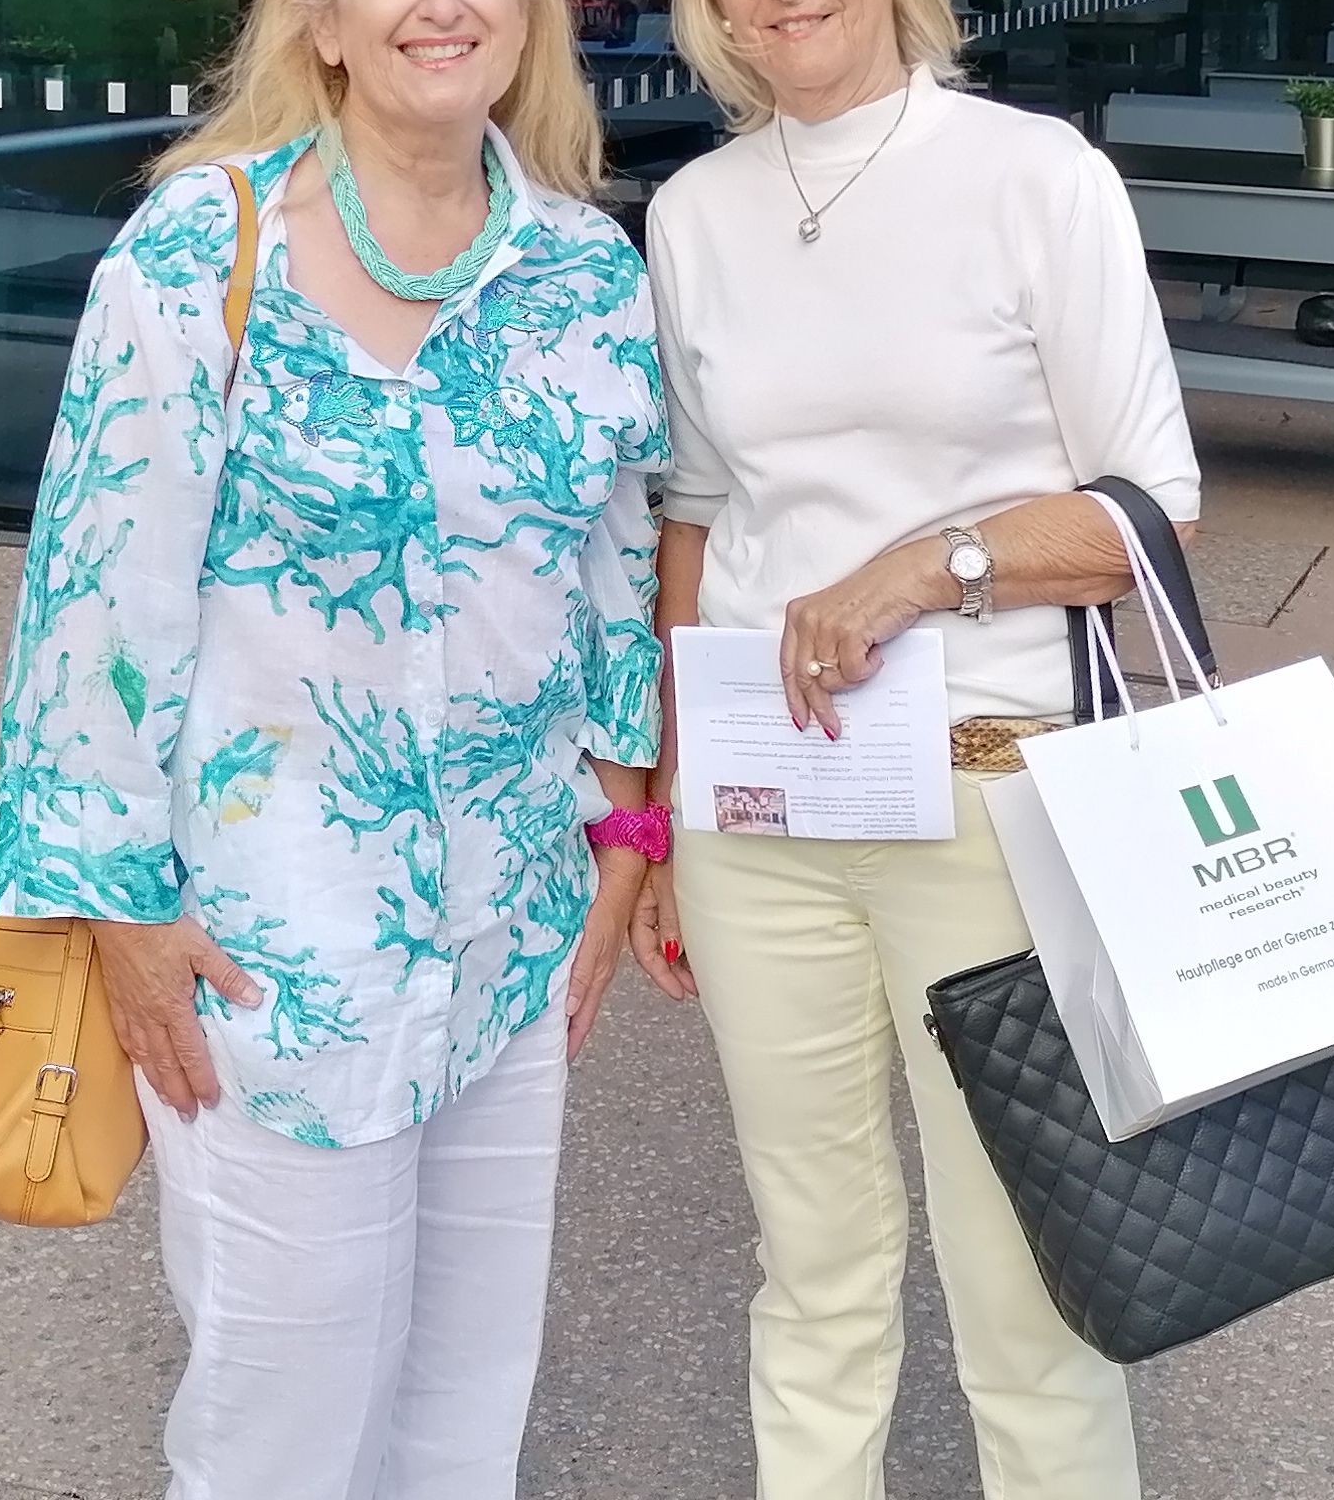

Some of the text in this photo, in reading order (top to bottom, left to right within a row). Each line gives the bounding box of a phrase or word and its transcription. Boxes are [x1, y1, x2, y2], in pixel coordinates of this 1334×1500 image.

[1192, 837, 1298, 888] MBR
[1199, 868, 1319, 915] medical beauty
[1175, 951, 1244, 983] Hautpflege
[1244, 946, 1263, 961] an
[1263, 937, 1285, 953] der
[1284, 922, 1329, 946] Grenze
[1257, 973, 1289, 993] made
[1288, 969, 1300, 982] in
